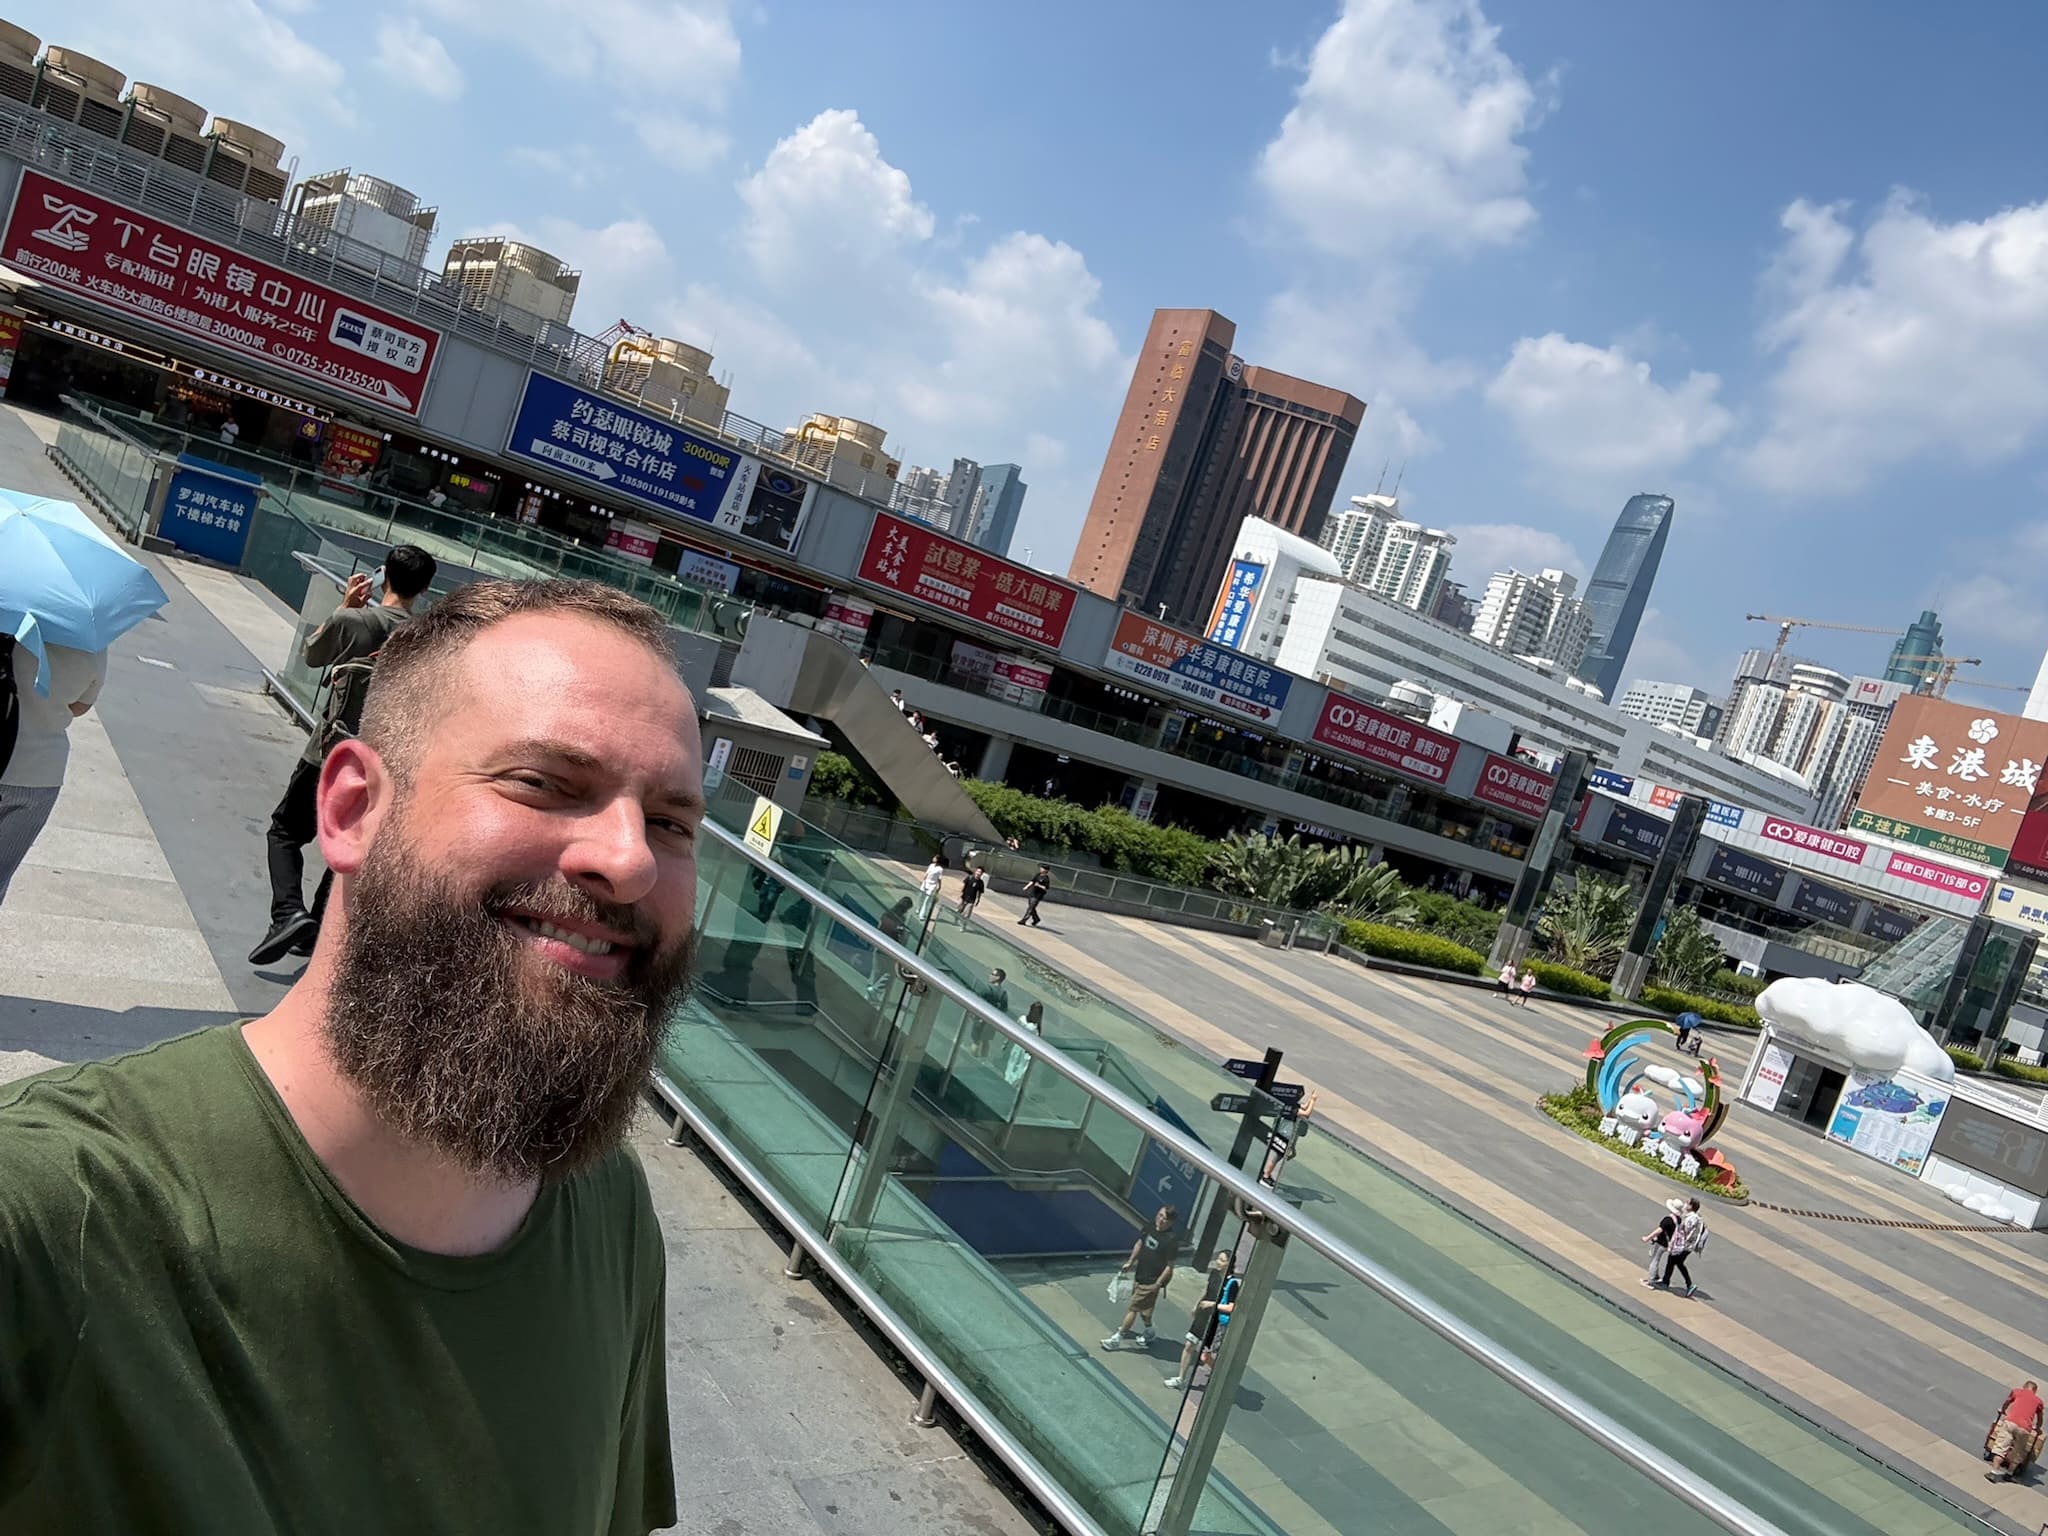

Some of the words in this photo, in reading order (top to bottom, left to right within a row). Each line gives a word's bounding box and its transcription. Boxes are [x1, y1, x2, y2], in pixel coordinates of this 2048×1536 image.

[104, 251, 176, 291] 专配渐进
[194, 285, 319, 344] 为港人服务25年
[15, 247, 82, 283] 前行200米
[286, 347, 384, 394] 0755-25125520
[339, 320, 364, 336] ZEISS
[366, 340, 417, 368] 授权店
[371, 326, 421, 354] 蔡司官方
[571, 398, 673, 457] 约瑟眼镜城
[551, 419, 678, 481] 蔡司视觉合作店
[682, 441, 731, 468] 30000呎
[175, 503, 242, 534] 下楼梯右转
[178, 486, 245, 517] 罗湖汽车站
[723, 511, 742, 526] 7F
[875, 525, 899, 572] 火车站
[885, 535, 909, 585] 美食城
[923, 541, 981, 581] 試營業
[995, 570, 1063, 612] 盛大開業
[1222, 571, 1257, 648] 希华爱康健
[1141, 625, 1272, 690] 深圳希华爱康健医院
[1355, 714, 1412, 749] 爱康健口腔
[1899, 734, 2043, 797] 東港城
[1915, 780, 2006, 815] 美食·水疗
[1855, 812, 1911, 840] 丹桂軒
[1923, 804, 1983, 829] 本座3-5F
[1793, 828, 1863, 862] 爱康健口腔
[1891, 858, 1968, 891] 富康口腔门诊部
